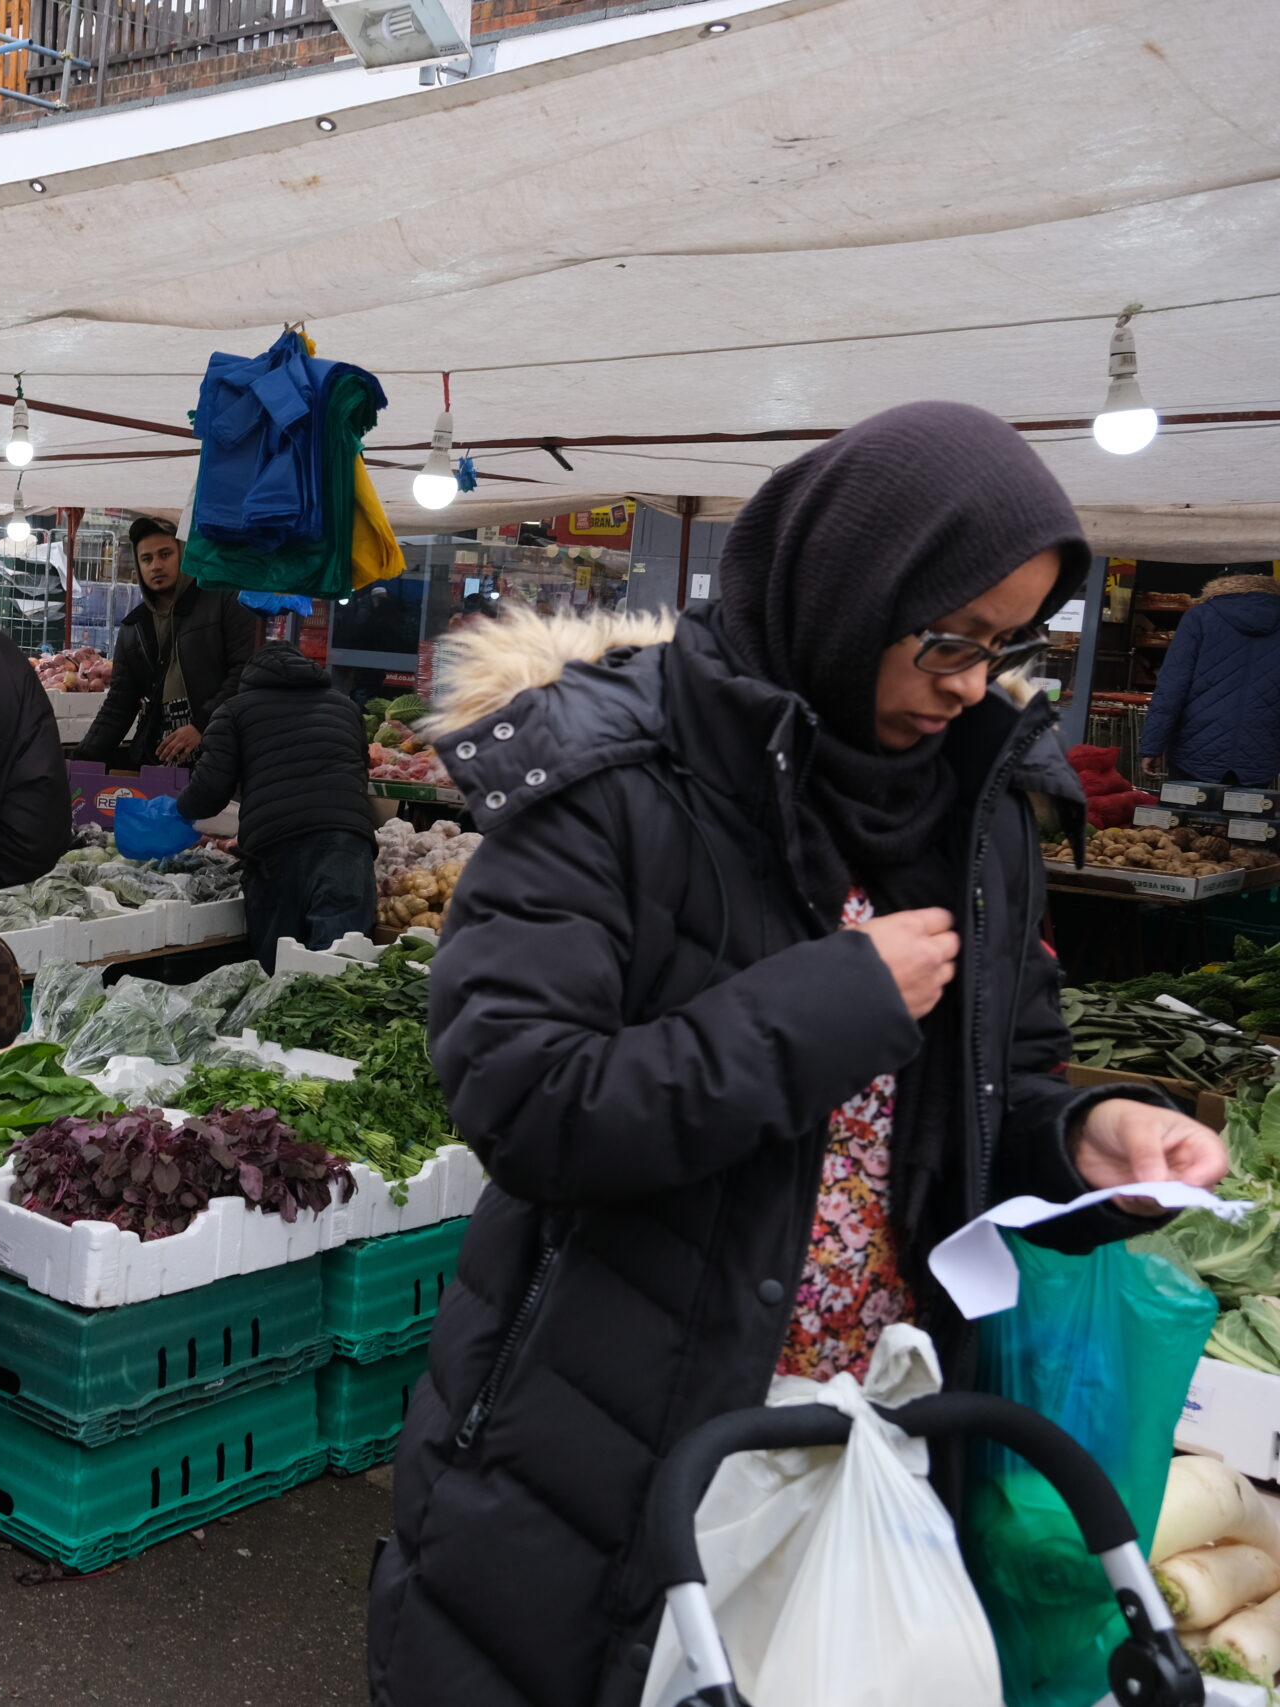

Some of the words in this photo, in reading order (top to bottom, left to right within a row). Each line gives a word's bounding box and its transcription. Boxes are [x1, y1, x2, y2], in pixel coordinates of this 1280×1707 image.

[591, 517, 620, 528] BRAN
[98, 798, 116, 808] RE
[1132, 880, 1158, 890] VEGET
[1160, 882, 1186, 893] FRESH
